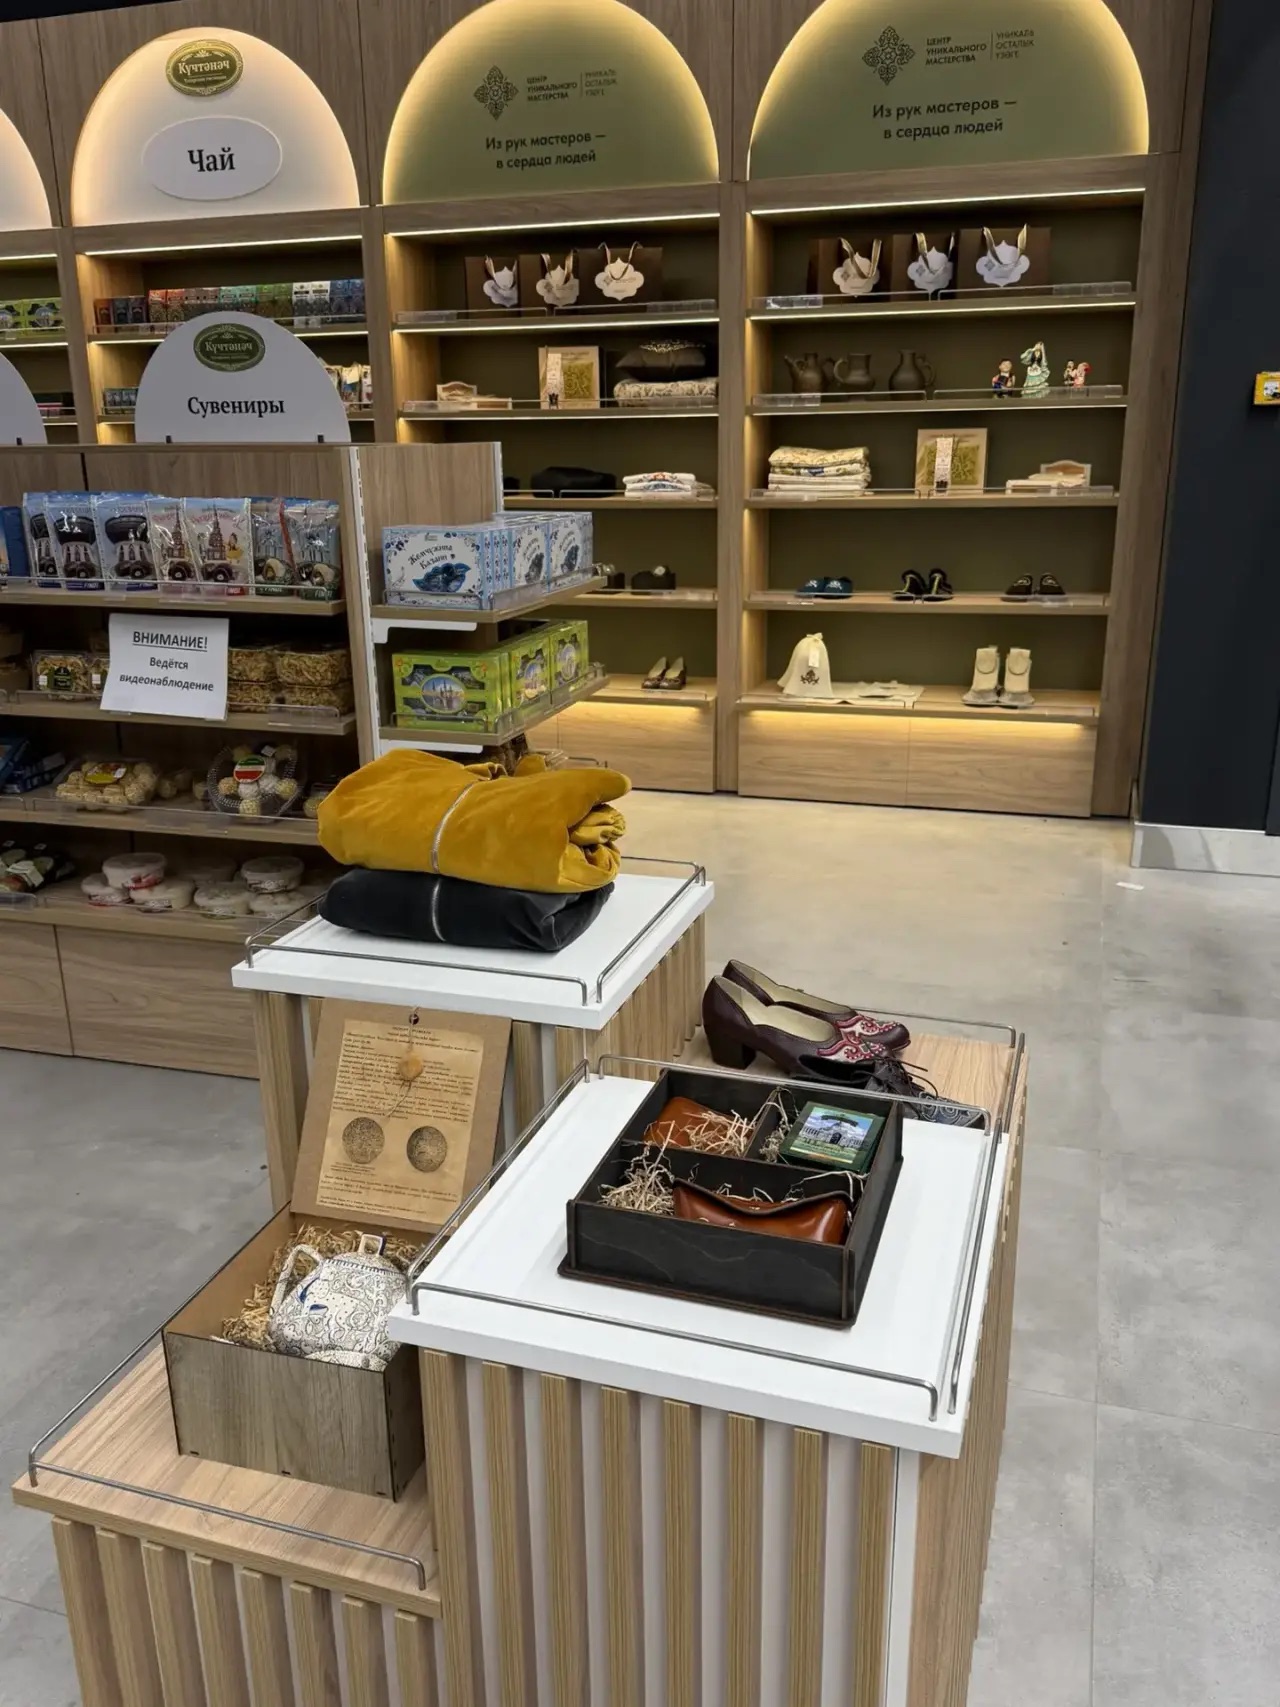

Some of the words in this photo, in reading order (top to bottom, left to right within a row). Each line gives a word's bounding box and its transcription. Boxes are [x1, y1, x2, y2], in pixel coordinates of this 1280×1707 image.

[926, 36, 952, 46] ЦЕНТР
[926, 43, 987, 56] УНИКАЛЬНОГО
[925, 54, 976, 66] МАСТЕРСТВА
[872, 104, 892, 119] Из
[896, 105, 922, 121] рук
[926, 99, 1000, 115] мастеров
[883, 129, 892, 139] в
[896, 124, 950, 141] сердца
[954, 118, 1003, 134] людей
[486, 137, 502, 150] Из
[505, 138, 528, 152] рук
[530, 133, 592, 147] мастеров
[187, 146, 236, 173] Чай
[496, 159, 504, 169] в
[506, 155, 552, 171] сердца
[555, 149, 597, 165] людей
[187, 396, 285, 419] Сувениры
[132, 630, 208, 650] ВНИМАНИЕ!
[149, 656, 189, 670] Ведётся
[119, 673, 214, 692] видеонаблюдение
